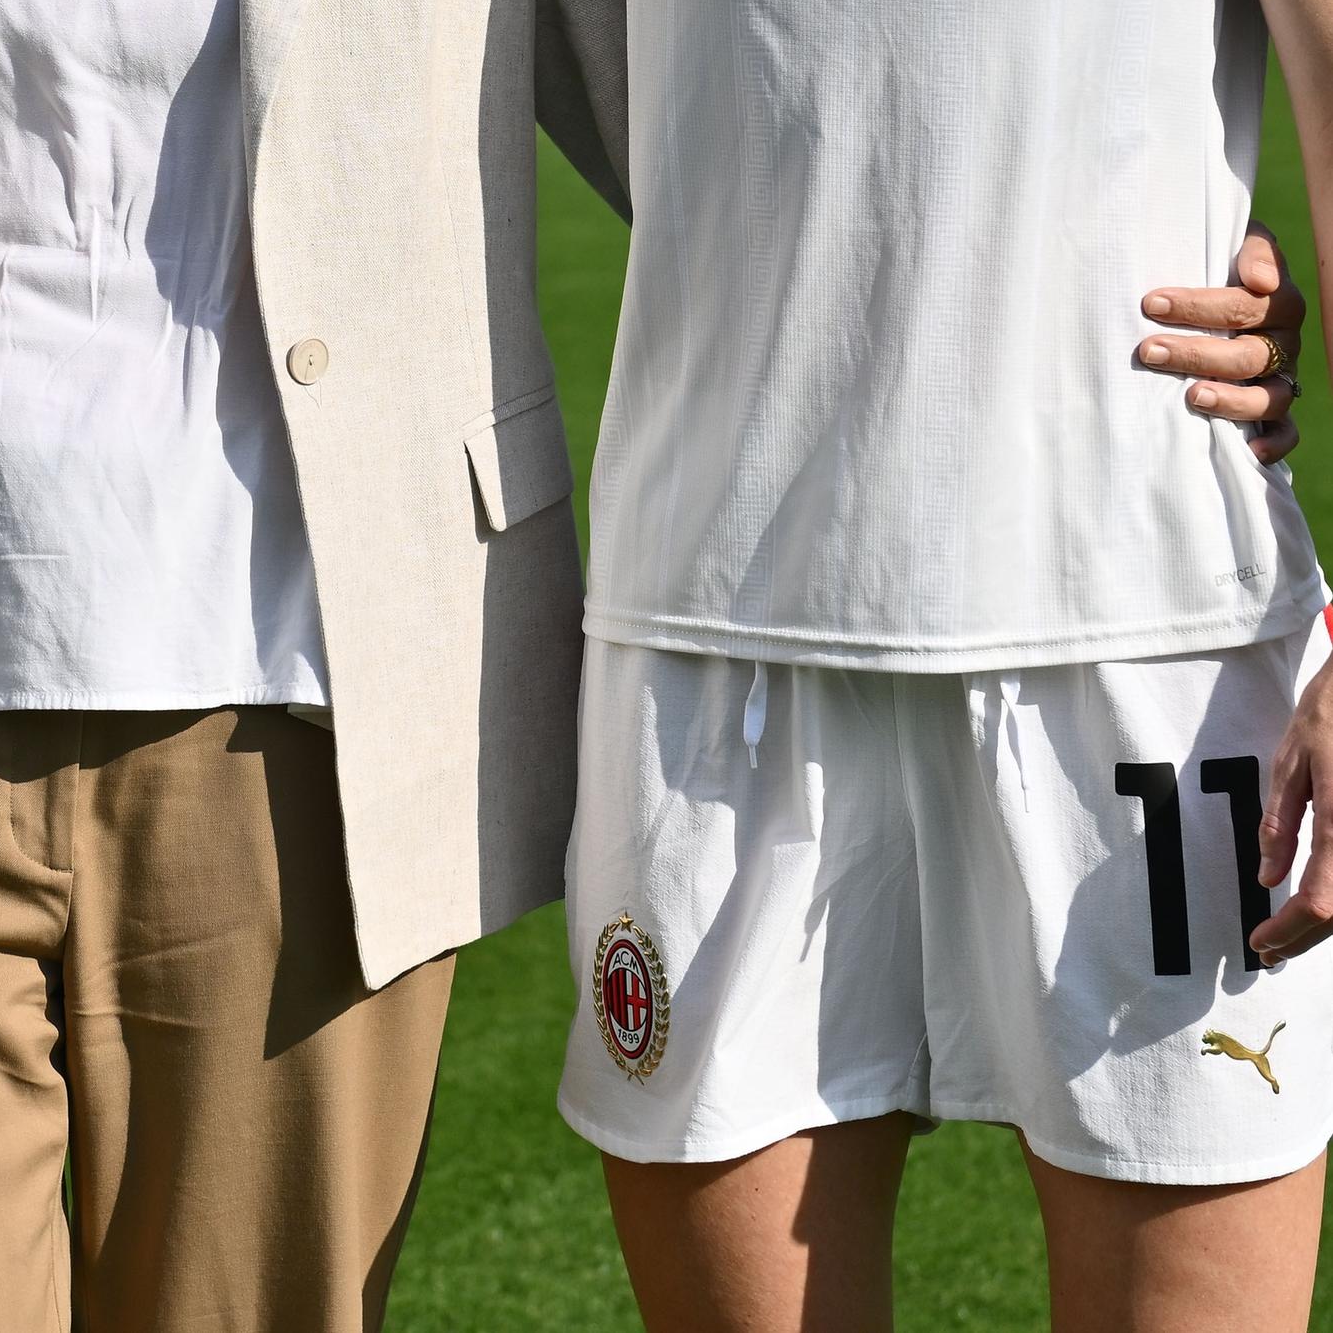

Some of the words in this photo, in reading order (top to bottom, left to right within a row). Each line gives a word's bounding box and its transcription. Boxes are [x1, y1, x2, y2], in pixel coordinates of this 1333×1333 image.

[1214, 563, 1266, 587] DRYCELL
[1115, 755, 1275, 976] 11
[613, 951, 639, 974] ACM
[617, 1029, 640, 1044] 1899
